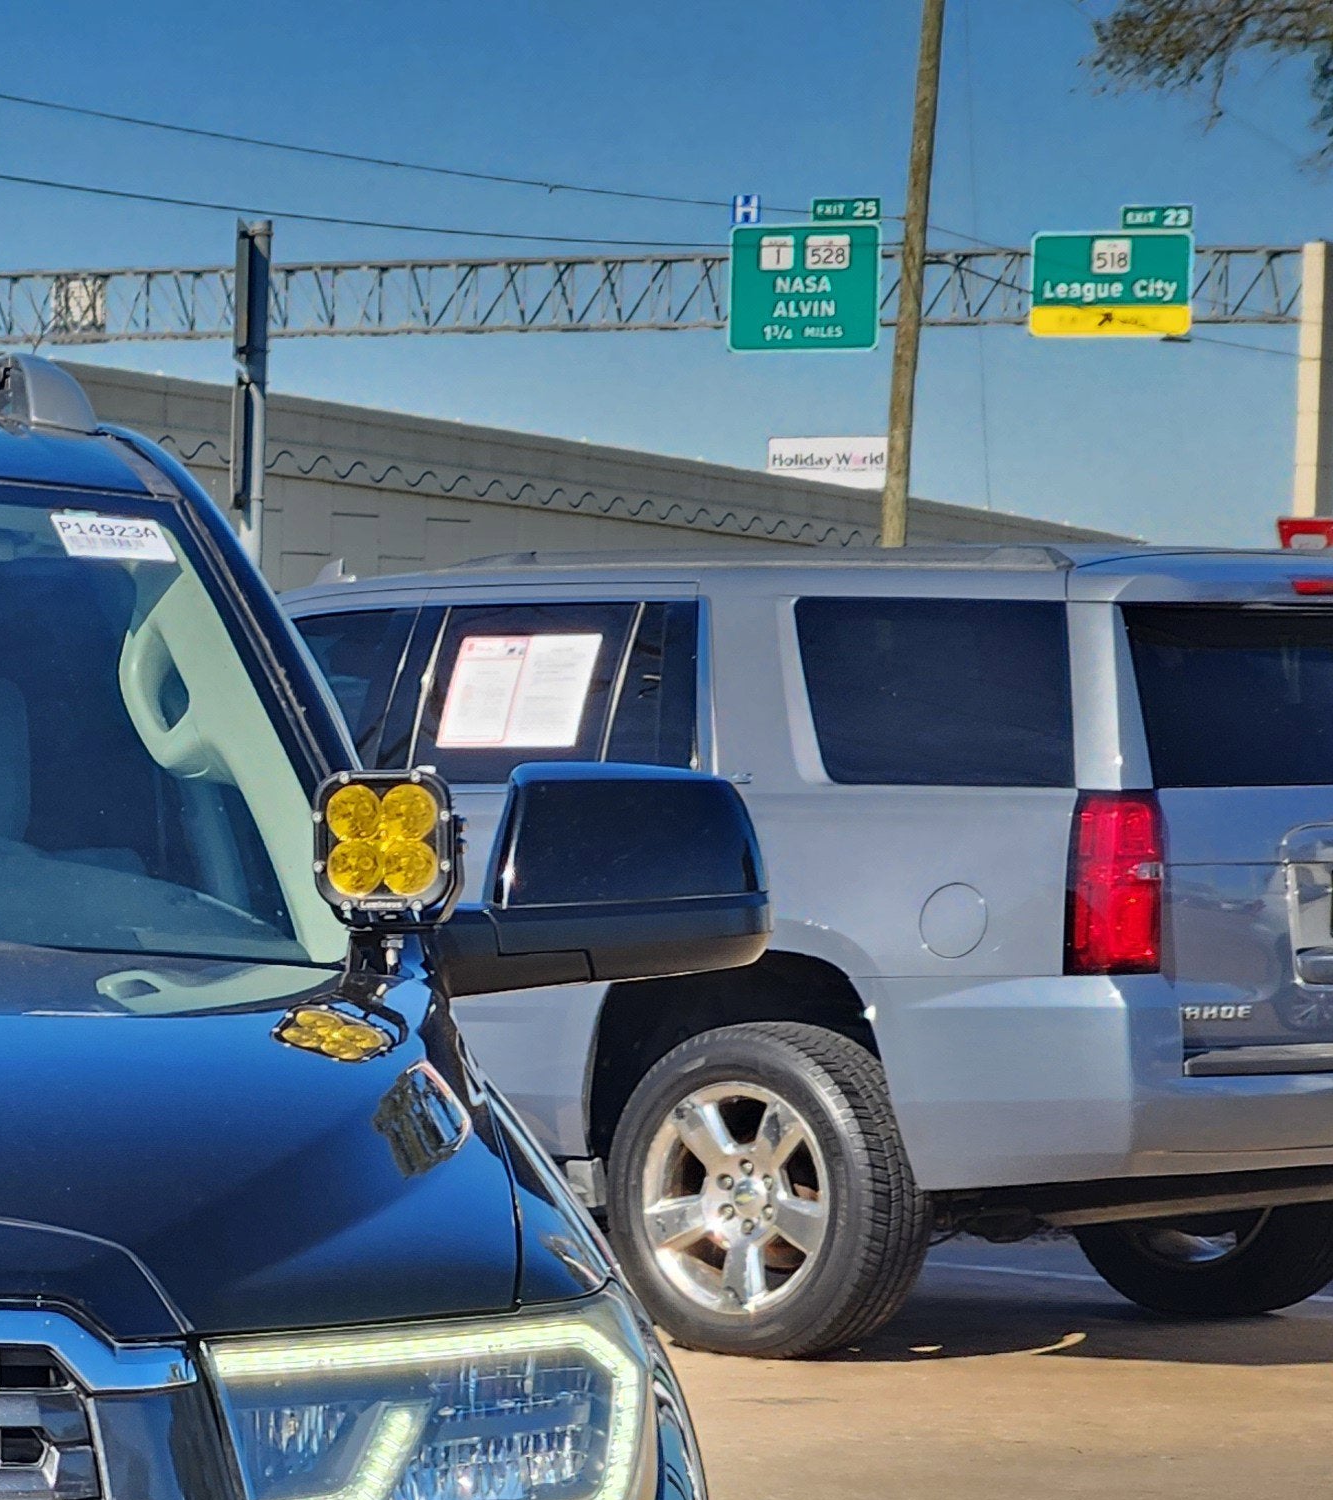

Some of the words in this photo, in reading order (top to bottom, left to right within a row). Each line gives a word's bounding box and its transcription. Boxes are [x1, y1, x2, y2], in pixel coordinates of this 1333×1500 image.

[735, 194, 759, 223] H
[816, 204, 845, 215] EXIT
[852, 201, 877, 217] 25
[1125, 211, 1156, 224] EXIT
[1163, 209, 1189, 226] 23
[775, 247, 781, 265] 1
[810, 247, 846, 265] 528
[1096, 252, 1128, 269] 518
[775, 275, 832, 294] NASA
[1042, 280, 1124, 303] League
[1132, 278, 1178, 301] City
[772, 300, 836, 318] ALVIN
[803, 325, 844, 338] MILES
[772, 453, 833, 468] Holiday
[58, 521, 158, 539] P14923A
[1179, 1004, 1253, 1020] AHOE
